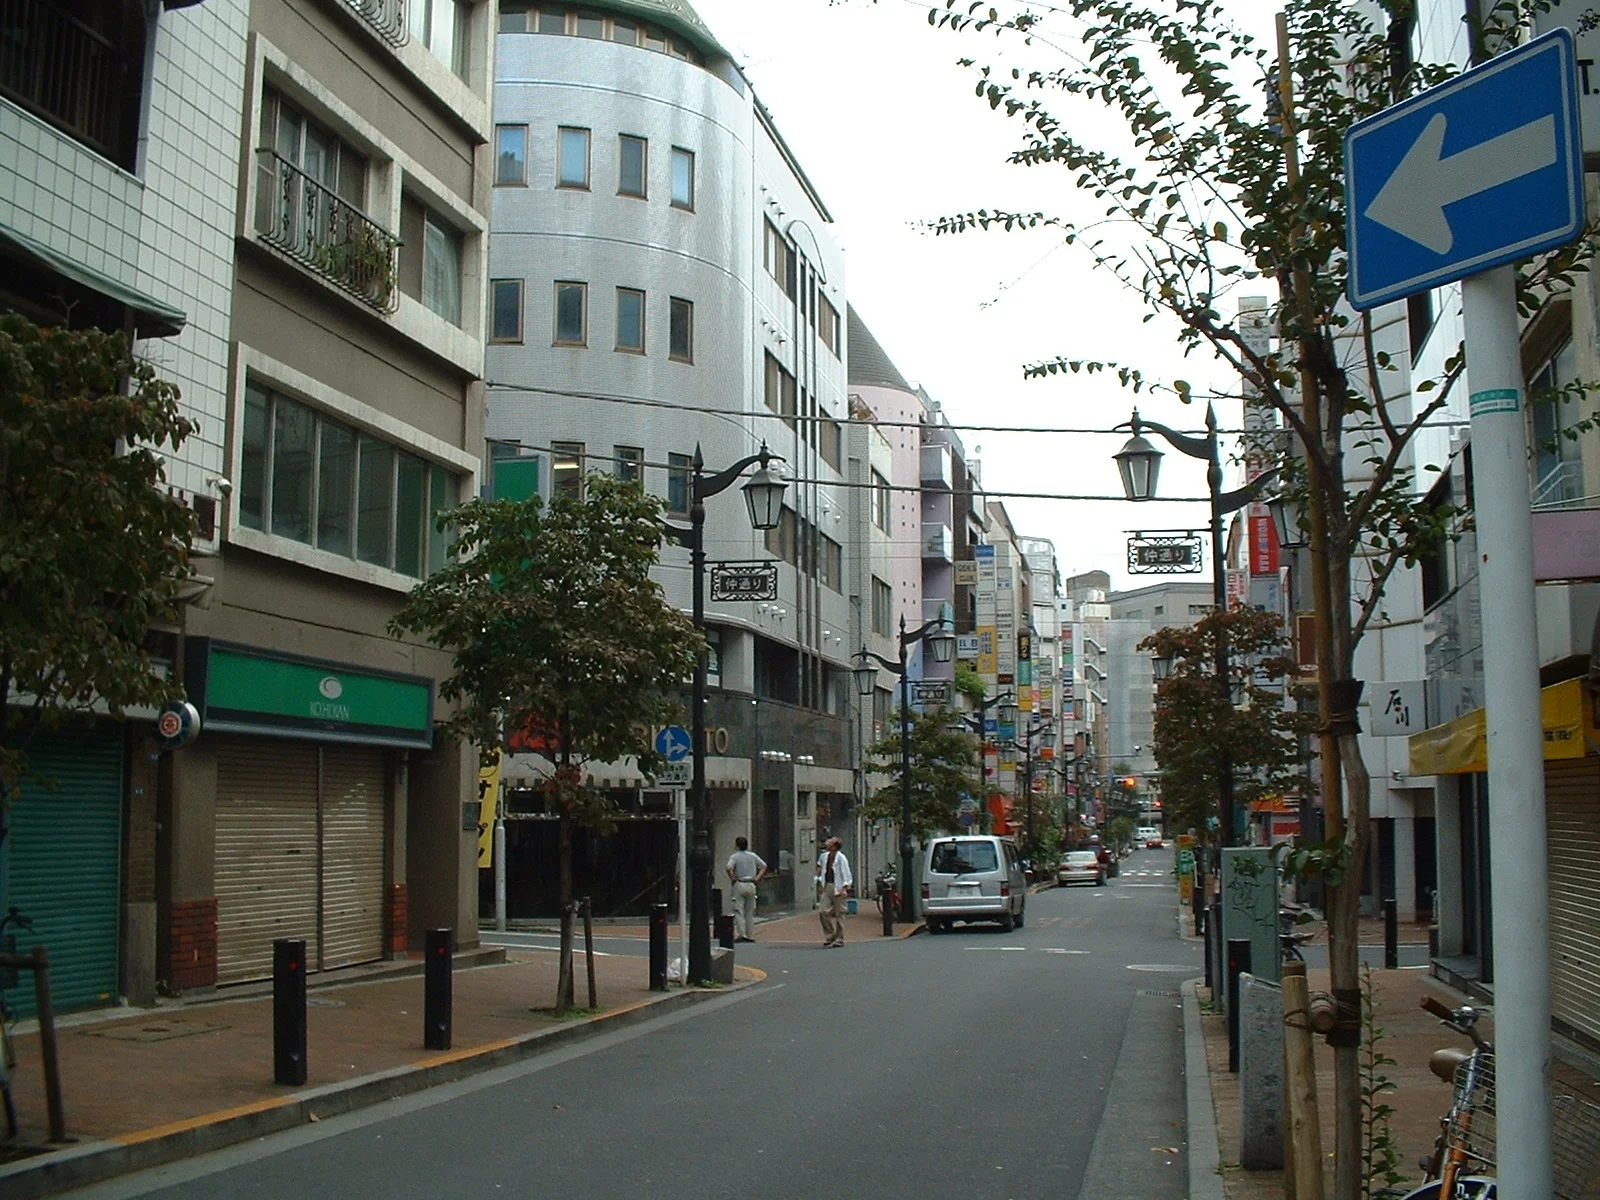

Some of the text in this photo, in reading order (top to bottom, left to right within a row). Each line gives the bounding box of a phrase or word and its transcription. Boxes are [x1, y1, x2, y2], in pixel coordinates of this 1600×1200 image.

[1144, 548, 1185, 562] 仲通り
[725, 577, 761, 591] 仲通り
